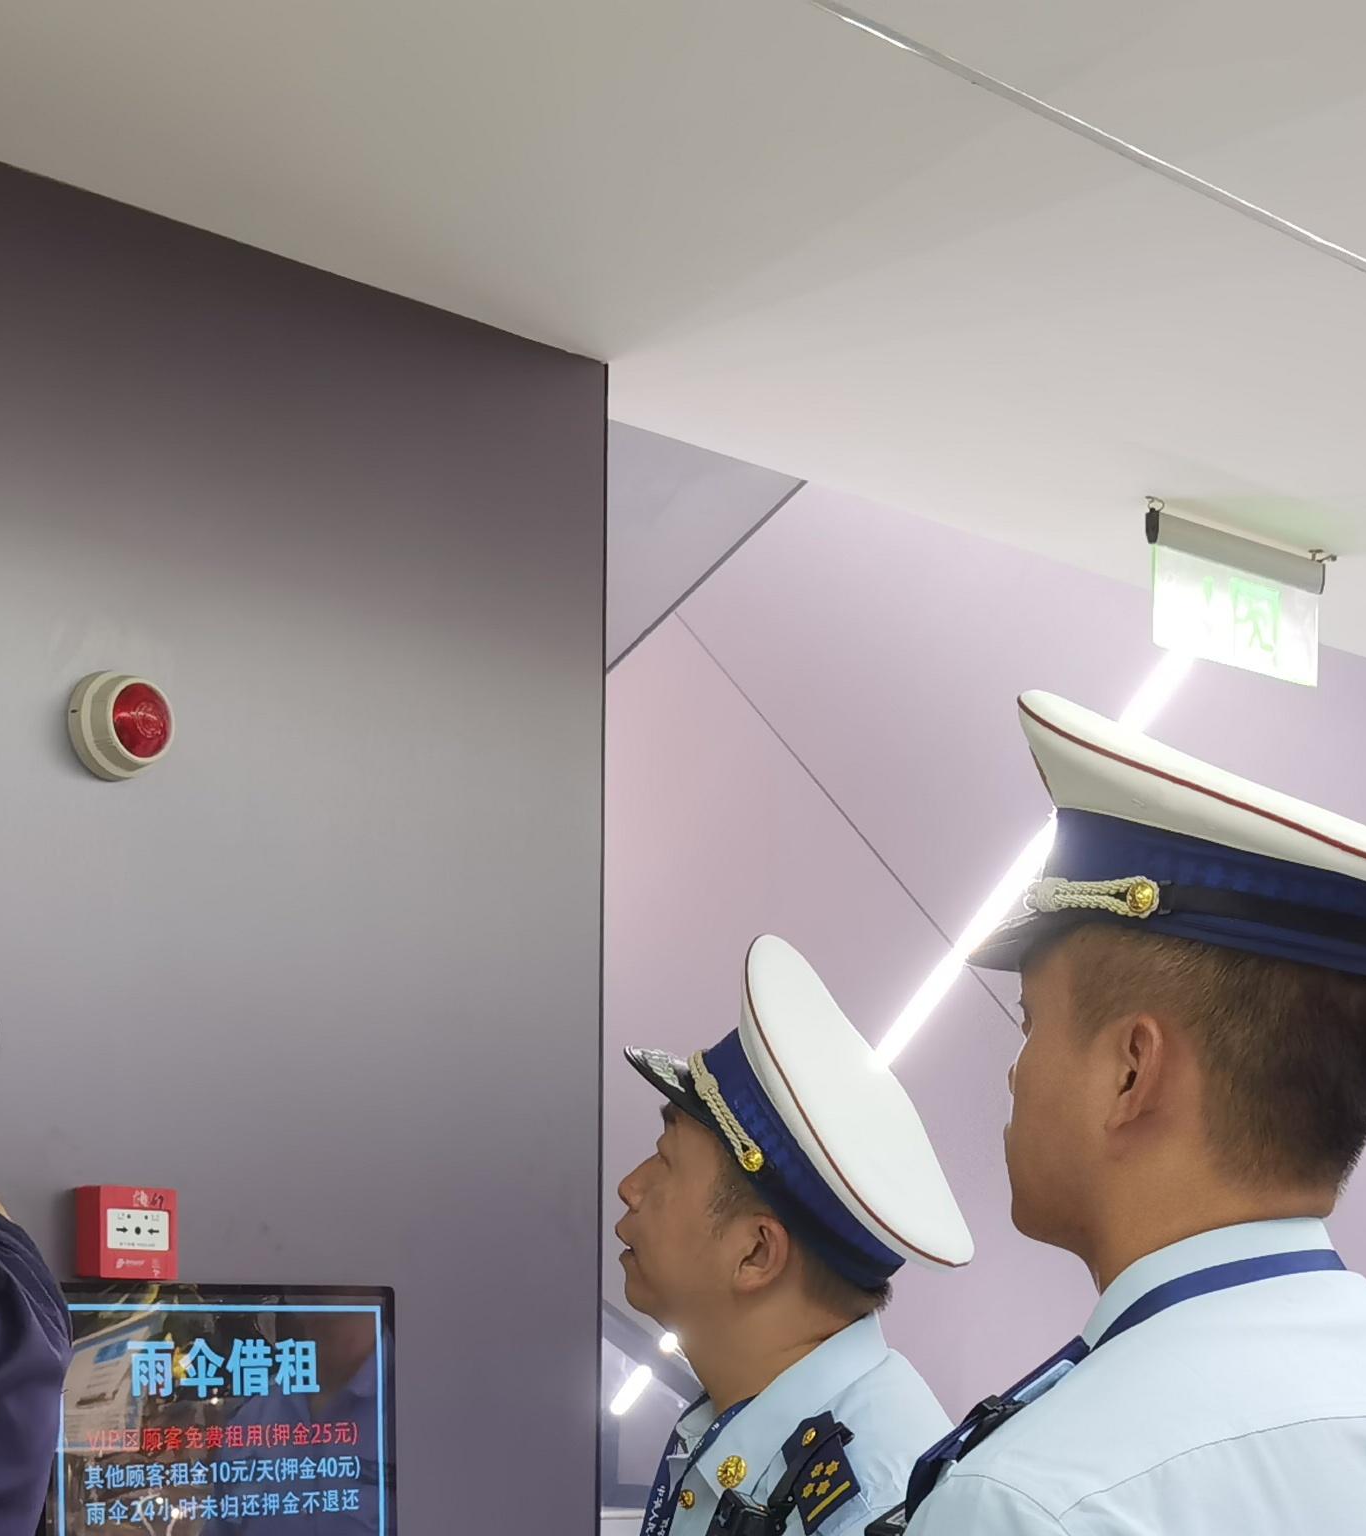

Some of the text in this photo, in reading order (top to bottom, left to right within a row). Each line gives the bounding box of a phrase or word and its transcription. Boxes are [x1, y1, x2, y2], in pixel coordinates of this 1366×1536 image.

[127, 1337, 320, 1397] 雨伞借租
[85, 1421, 360, 1452] VIP区顾客免费租用(押金25元)
[84, 1455, 361, 1490] 其他顾客:租金10元/天(押金40元)
[85, 1489, 360, 1526] 雨伞24小时未归还押金不退还
